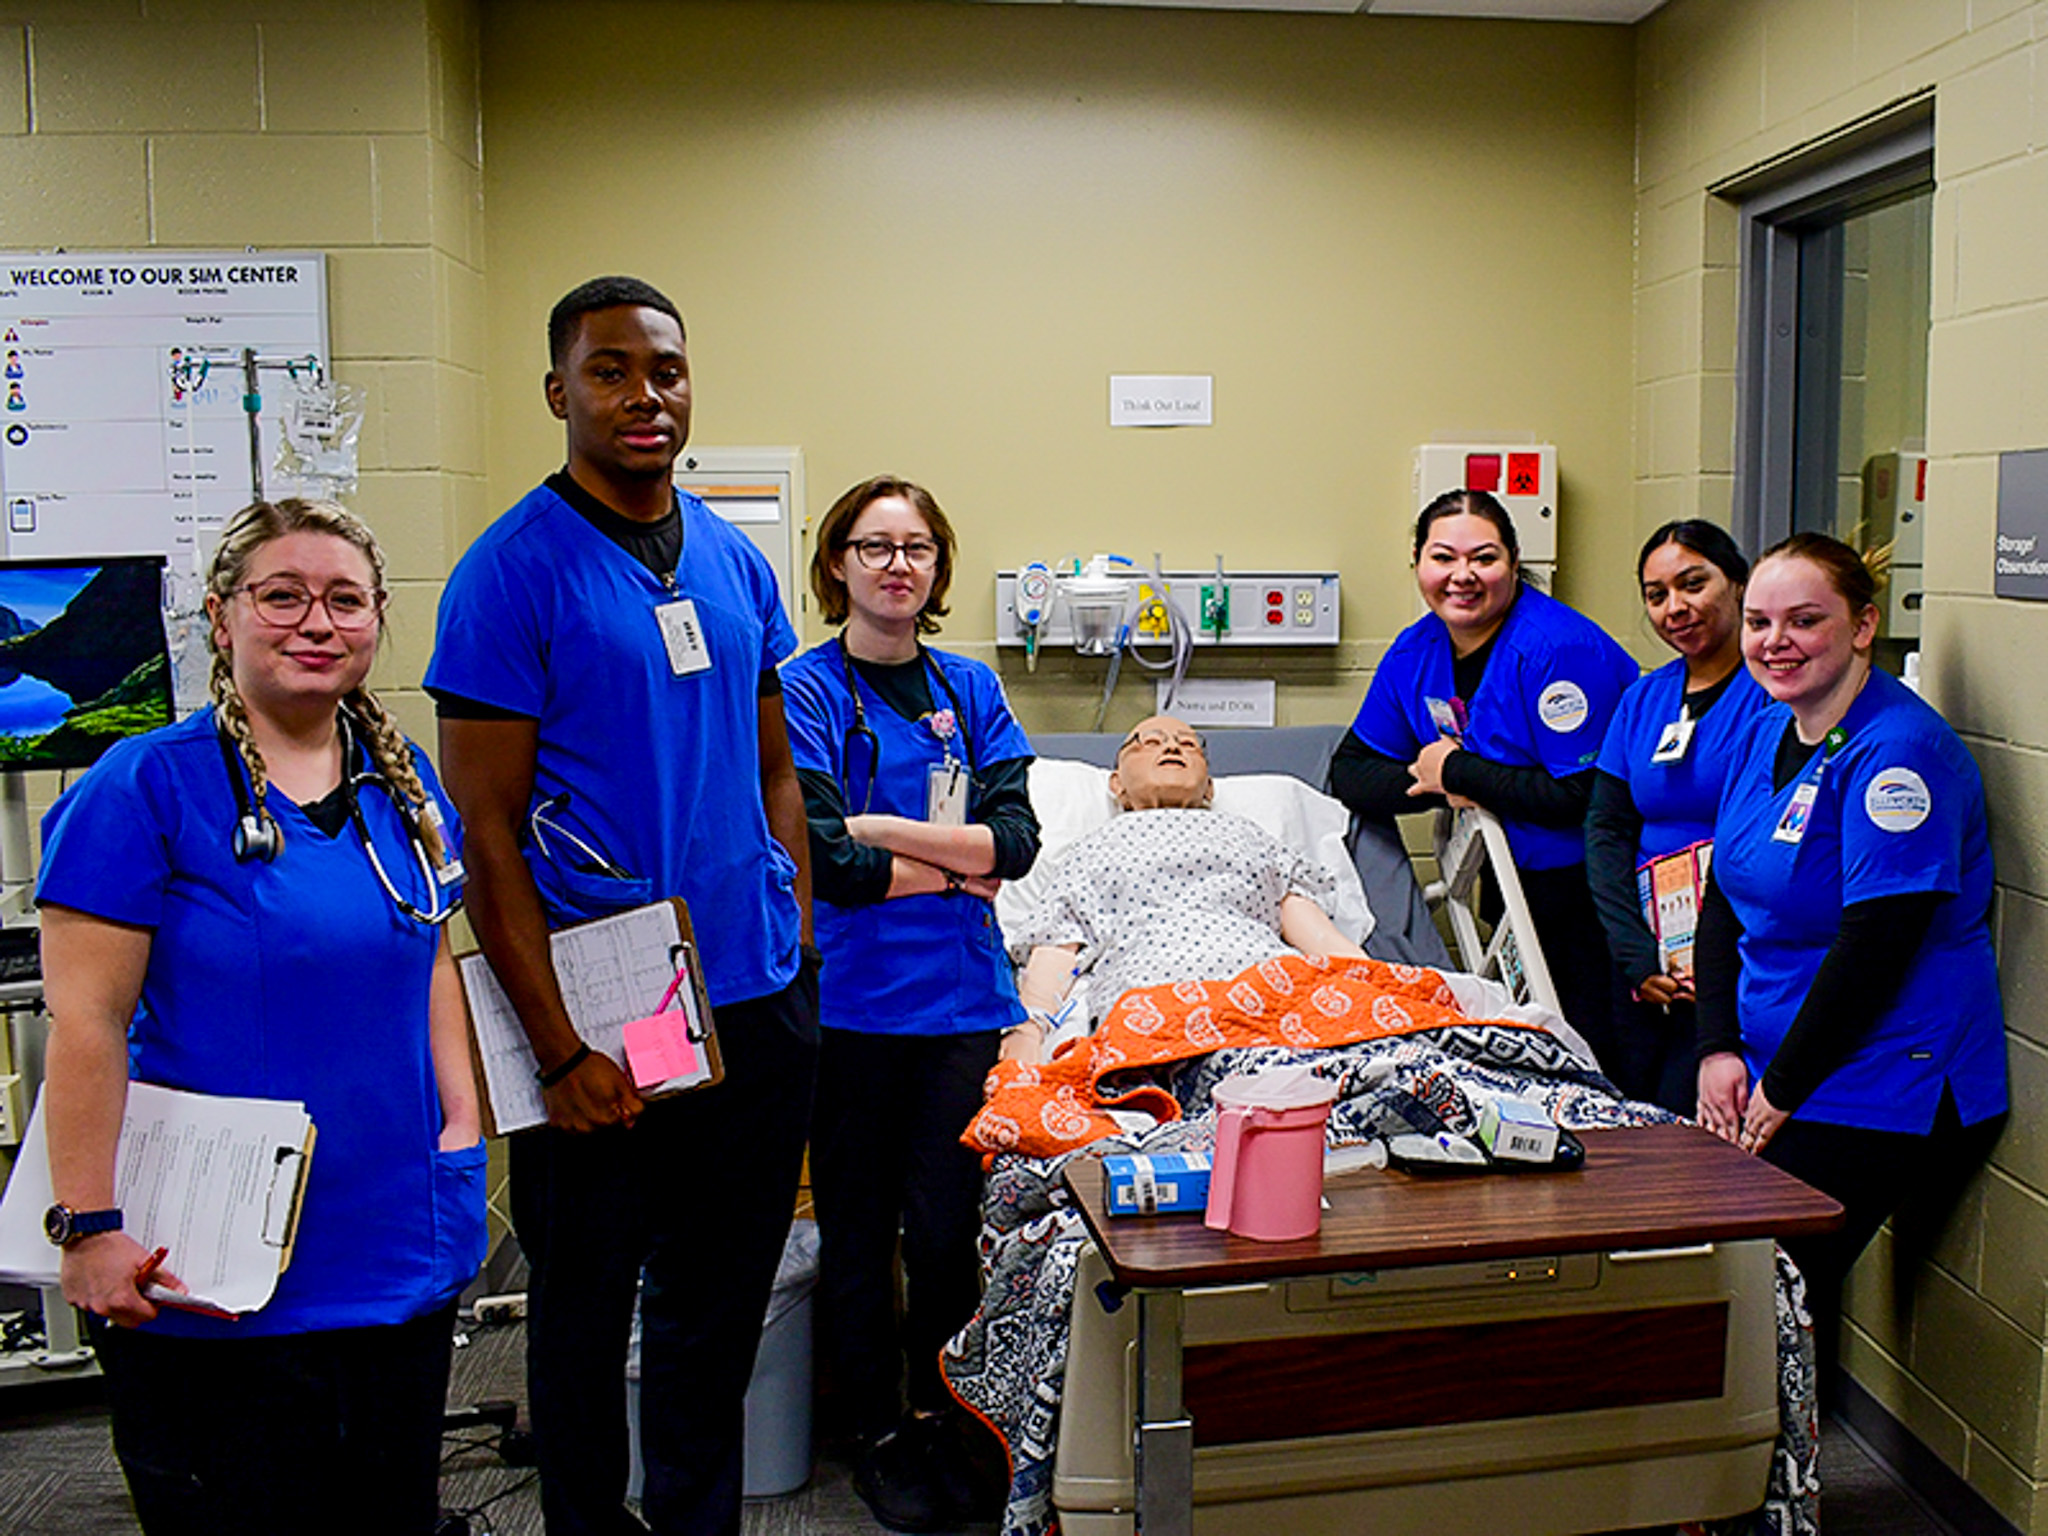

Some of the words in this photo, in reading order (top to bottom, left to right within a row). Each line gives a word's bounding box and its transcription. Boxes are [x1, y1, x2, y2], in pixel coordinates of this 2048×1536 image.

[11, 268, 104, 286] WELCOME
[109, 268, 137, 285] TO
[140, 267, 183, 285] OUR
[188, 267, 223, 284] SIM
[227, 266, 298, 283] CENTER
[1153, 398, 1173, 412] Out
